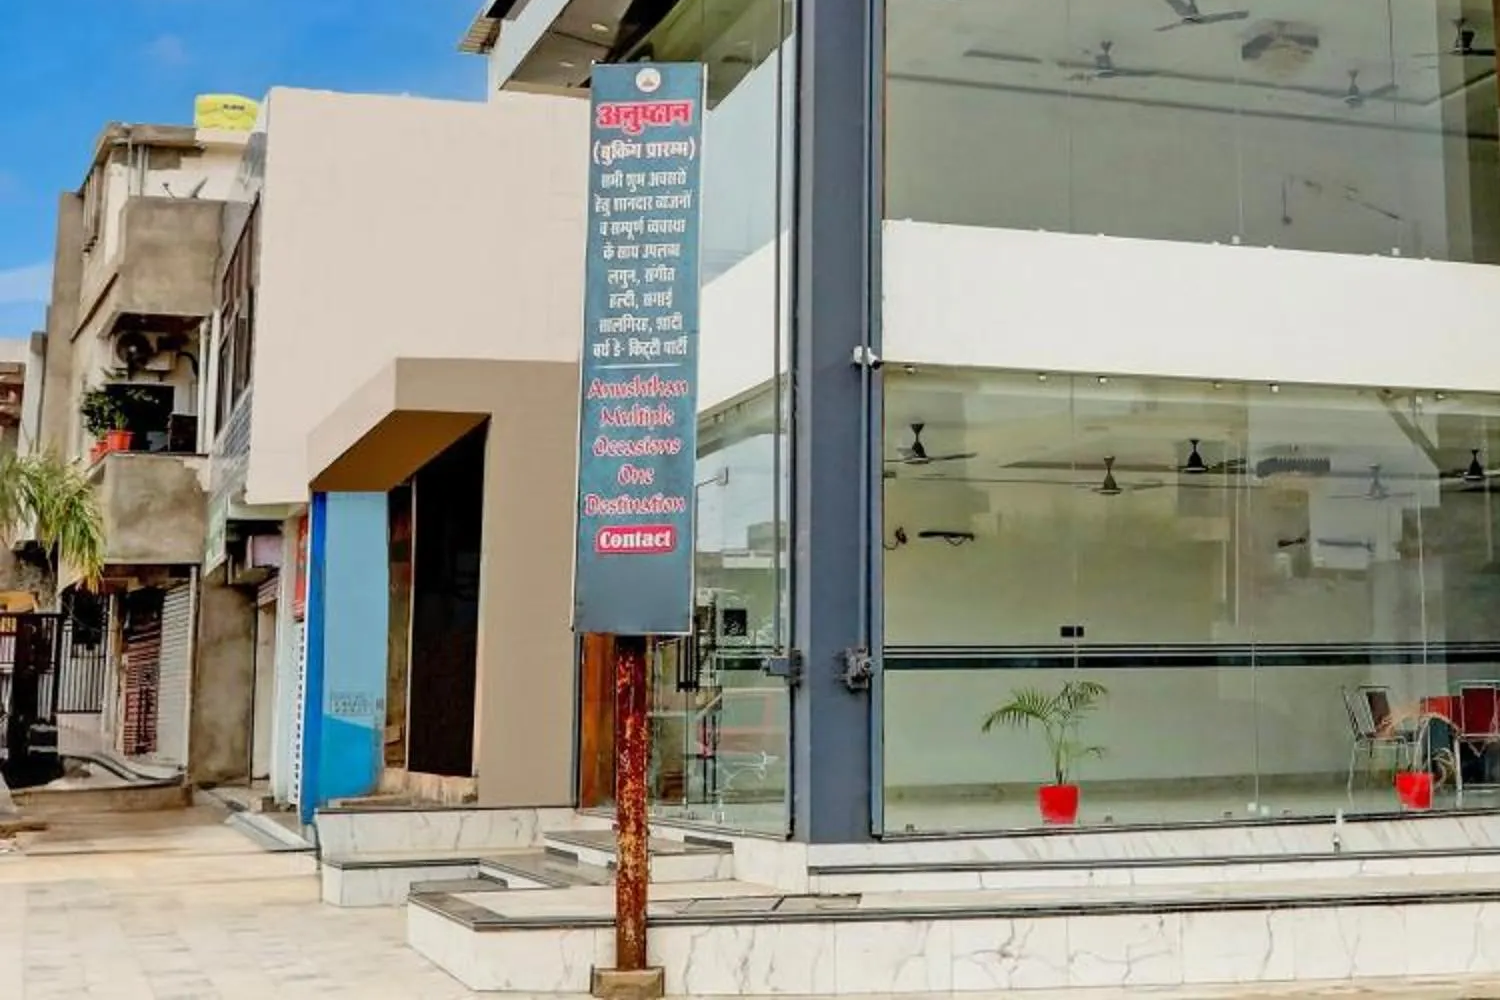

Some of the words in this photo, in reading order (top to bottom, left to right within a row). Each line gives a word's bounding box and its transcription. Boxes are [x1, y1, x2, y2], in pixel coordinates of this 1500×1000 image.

[618, 464, 655, 486] One
[585, 493, 687, 516] Destination
[600, 531, 672, 549] Contact
